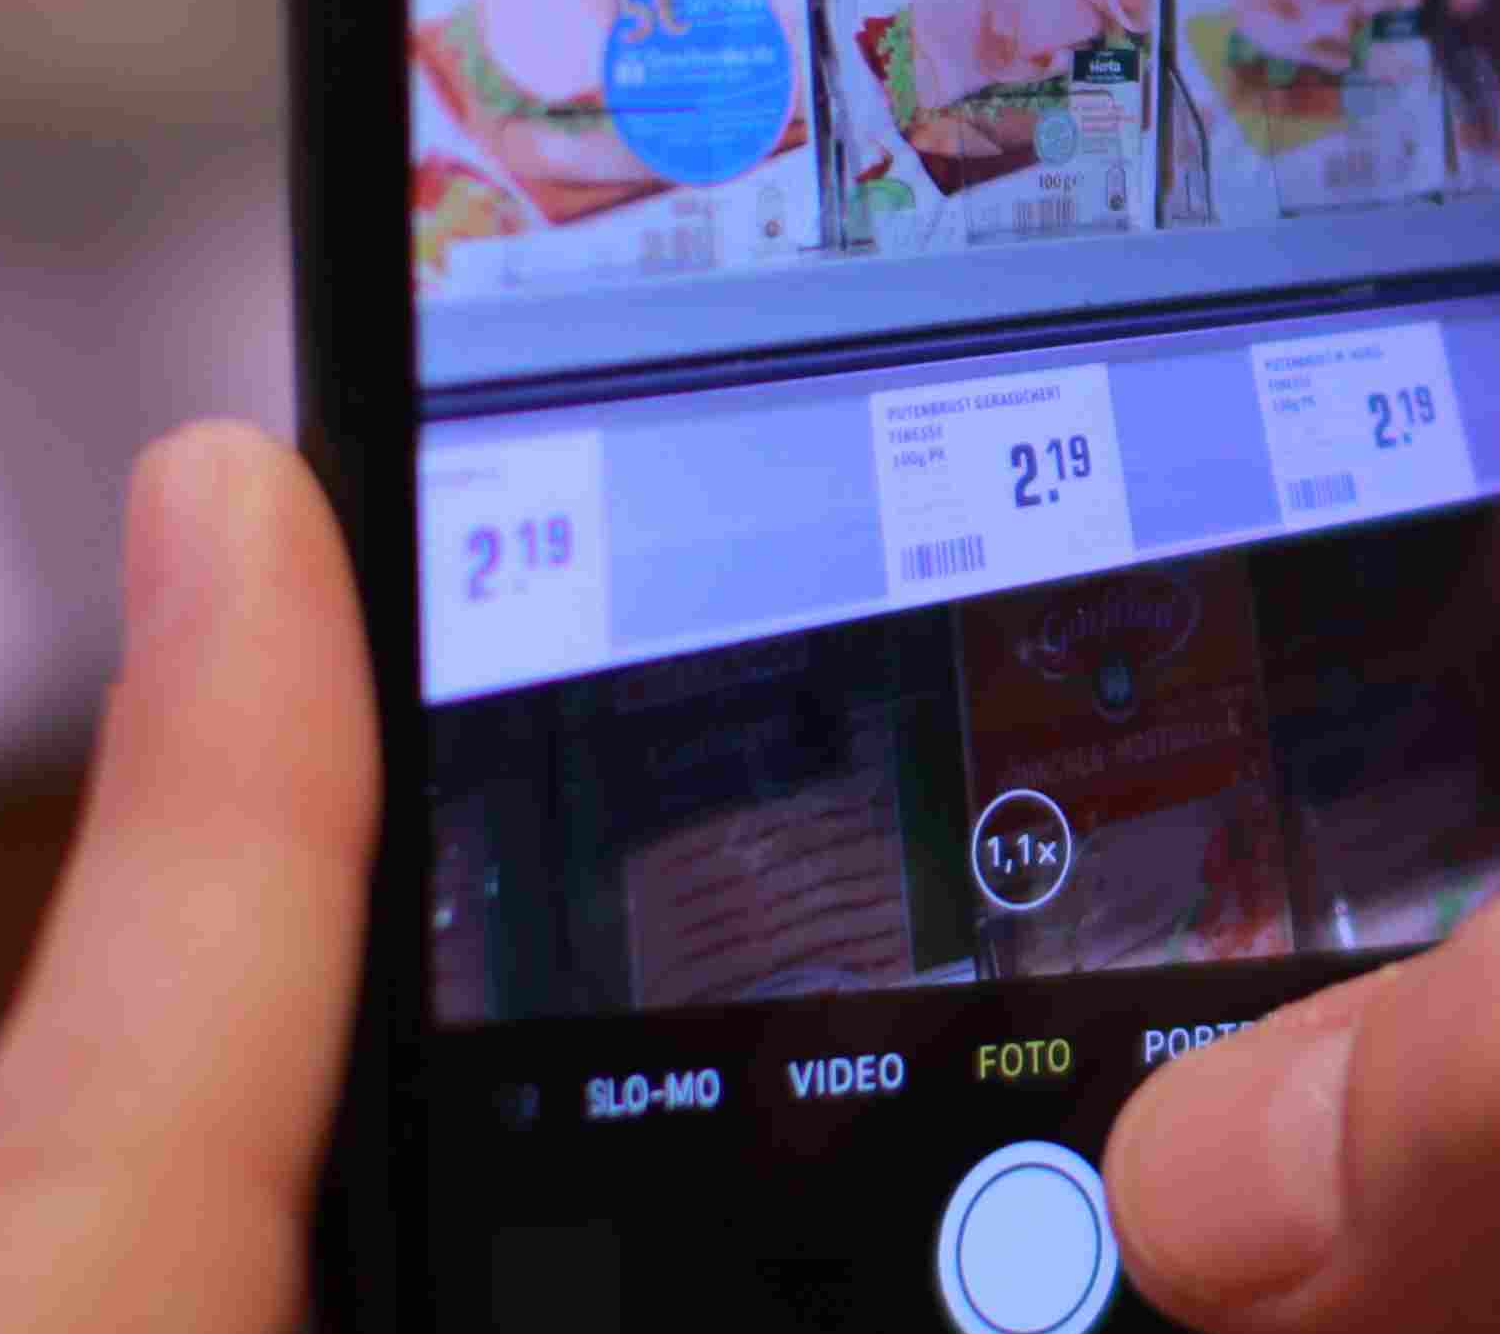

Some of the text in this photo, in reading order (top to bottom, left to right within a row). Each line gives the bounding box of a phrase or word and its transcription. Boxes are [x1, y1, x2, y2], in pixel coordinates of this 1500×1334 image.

[1367, 383, 1436, 450] 2.19
[1009, 433, 1092, 509] 2.19
[987, 832, 1058, 875] 1,1x
[585, 1068, 721, 1119] SLO-MO
[787, 1052, 905, 1099] VIDEO
[978, 1038, 1072, 1081] FOTO
